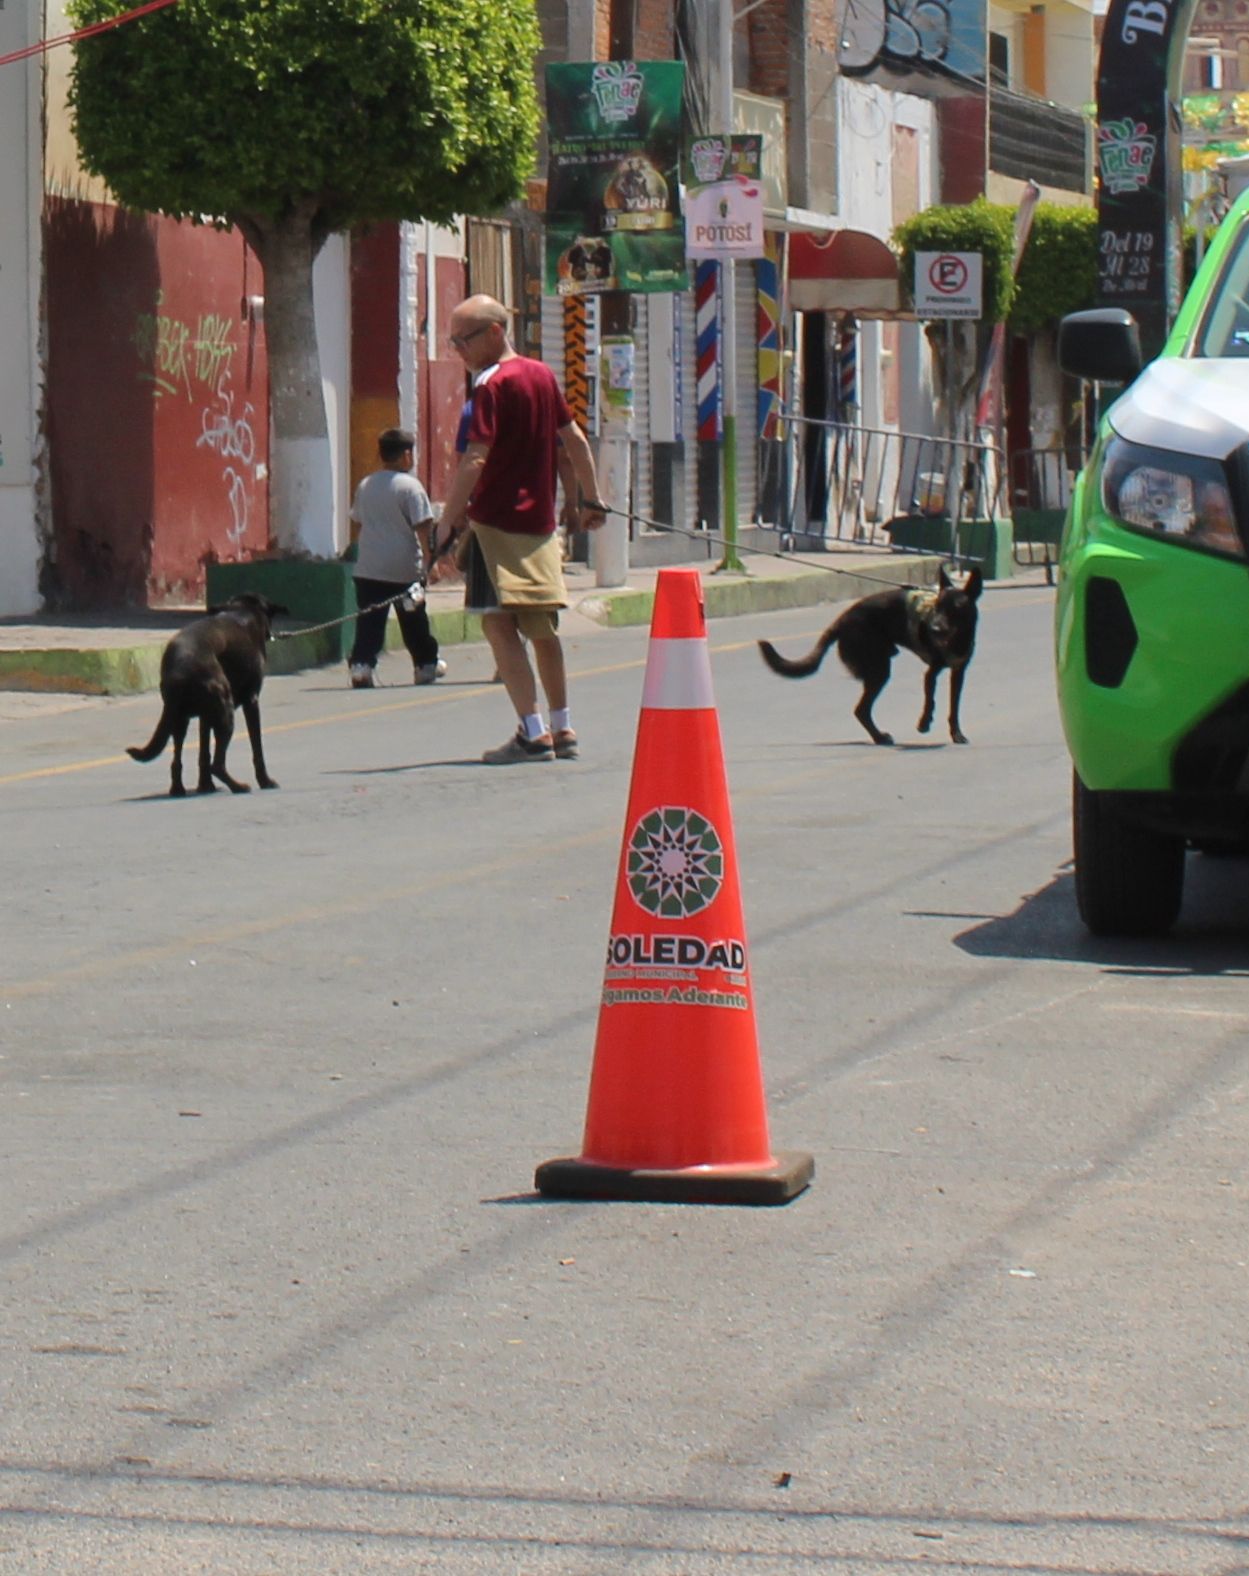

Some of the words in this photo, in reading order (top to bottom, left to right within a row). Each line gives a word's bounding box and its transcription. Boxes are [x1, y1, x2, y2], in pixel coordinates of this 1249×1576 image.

[695, 222, 752, 242] POTOSÍ
[1135, 231, 1154, 252] 19
[1128, 256, 1150, 276] 28
